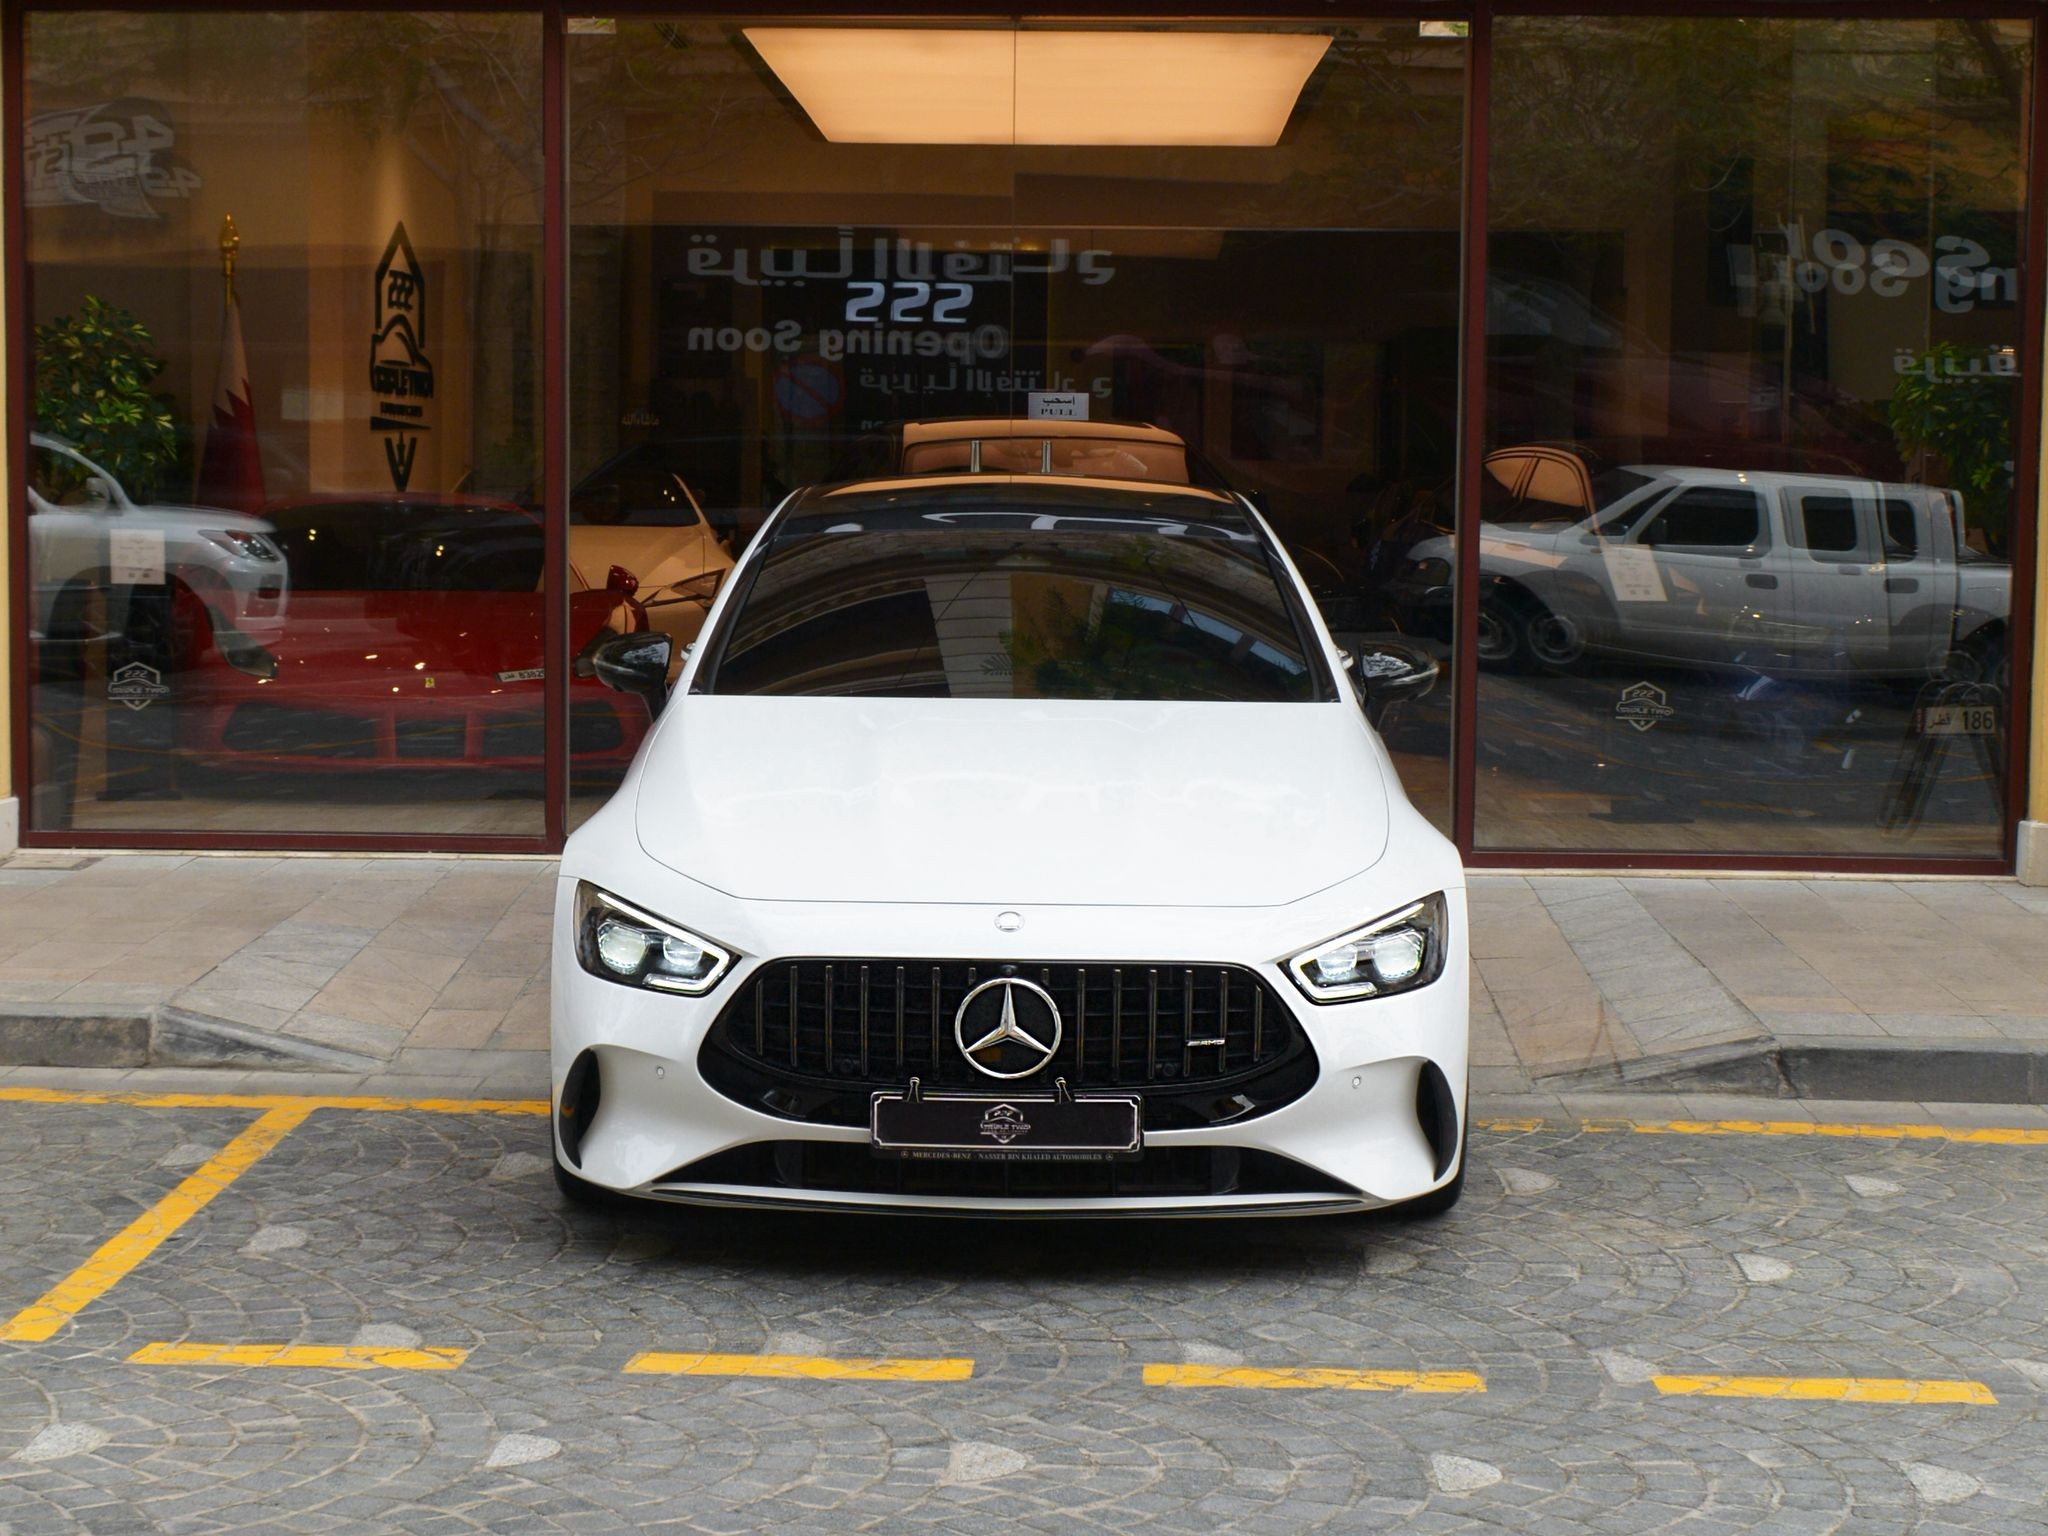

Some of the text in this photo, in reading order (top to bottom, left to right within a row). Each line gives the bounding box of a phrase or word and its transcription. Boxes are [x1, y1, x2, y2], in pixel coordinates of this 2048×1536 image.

[844, 281, 974, 324] 222
[124, 670, 148, 678] 222
[1632, 690, 1655, 698] 222
[1962, 710, 1993, 730] 186
[979, 1152, 1007, 1161] NASSER
[1007, 1153, 1020, 1161] BIN
[1021, 1153, 1051, 1161] KHALED
[1052, 1153, 1103, 1162] AUTOMOBILES
